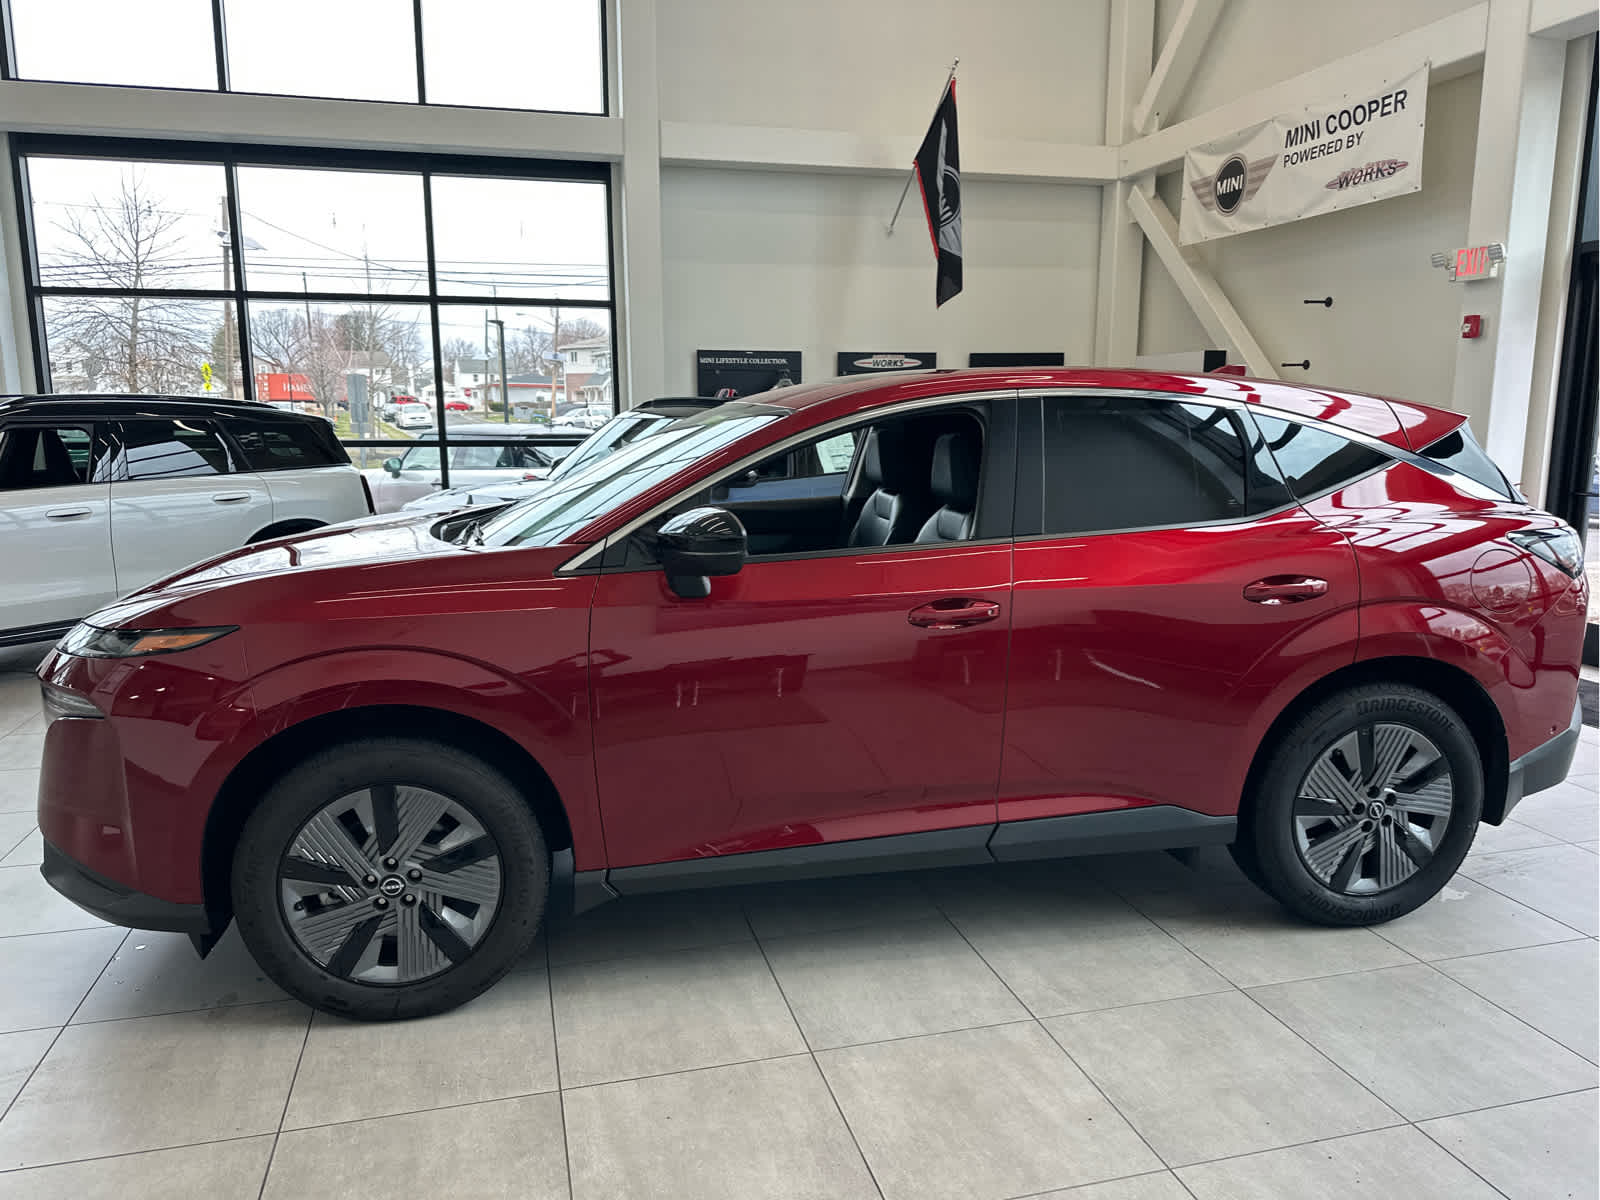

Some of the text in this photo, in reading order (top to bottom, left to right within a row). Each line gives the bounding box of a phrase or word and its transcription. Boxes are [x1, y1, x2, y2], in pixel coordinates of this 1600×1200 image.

[1284, 89, 1408, 149] MINI COOPER
[1283, 138, 1343, 169] POWERED
[1346, 130, 1364, 150] BY
[1216, 173, 1244, 197] MINI
[1338, 162, 1398, 189] WORKS
[1456, 246, 1489, 277] EXIT
[872, 359, 905, 368] WORKS
